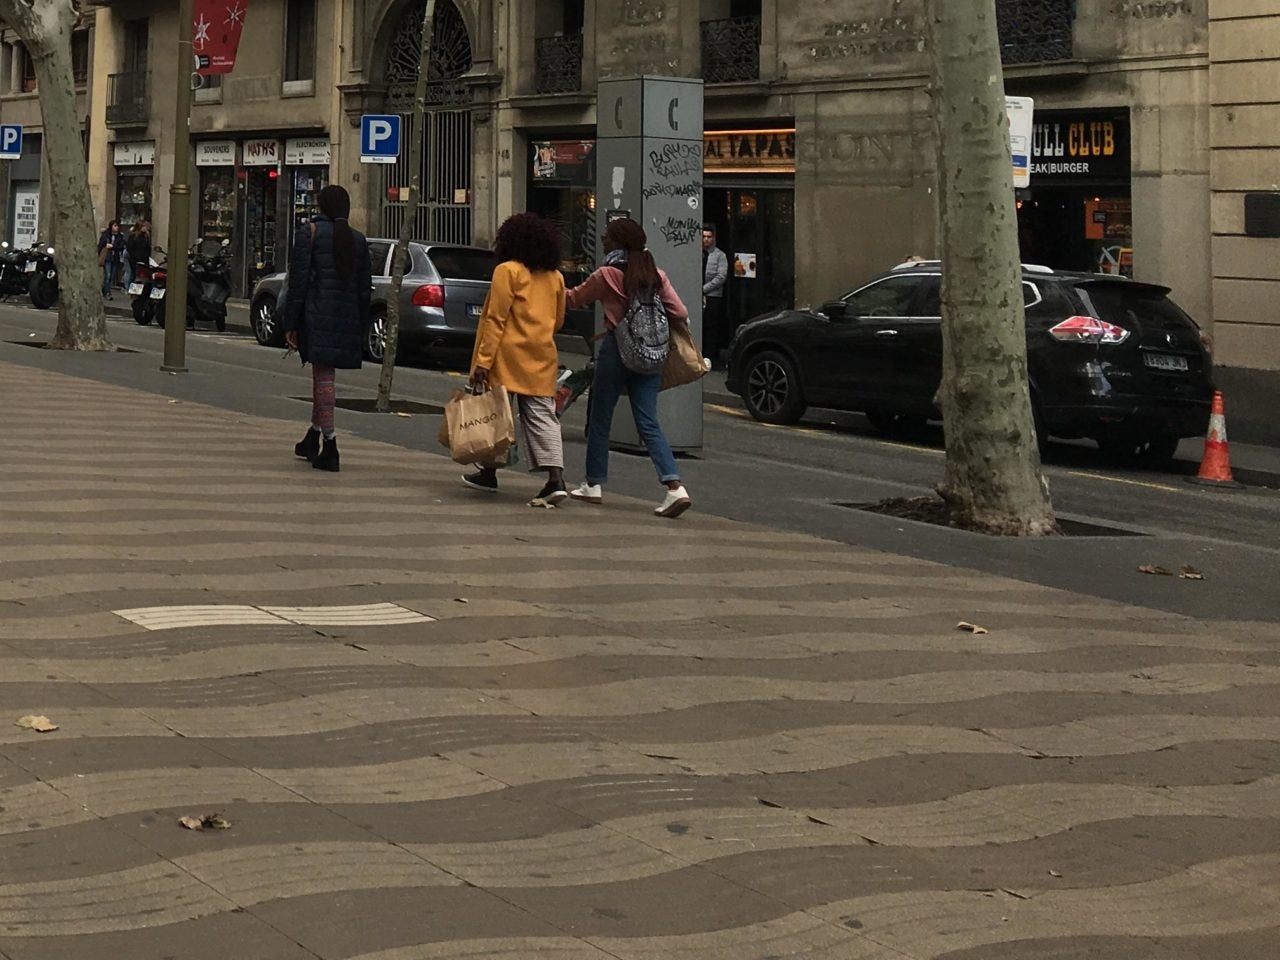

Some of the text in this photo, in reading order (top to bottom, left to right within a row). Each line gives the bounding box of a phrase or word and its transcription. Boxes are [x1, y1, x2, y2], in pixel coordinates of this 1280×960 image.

[3, 127, 18, 151] P
[368, 120, 392, 151] P
[704, 138, 724, 157] AL
[728, 133, 796, 158] TAPAS
[1032, 121, 1115, 157] ULL CLUB
[203, 144, 231, 155] SOUVENIRS
[1030, 162, 1090, 174] EAK|BURGER
[459, 412, 497, 430] MANGO
